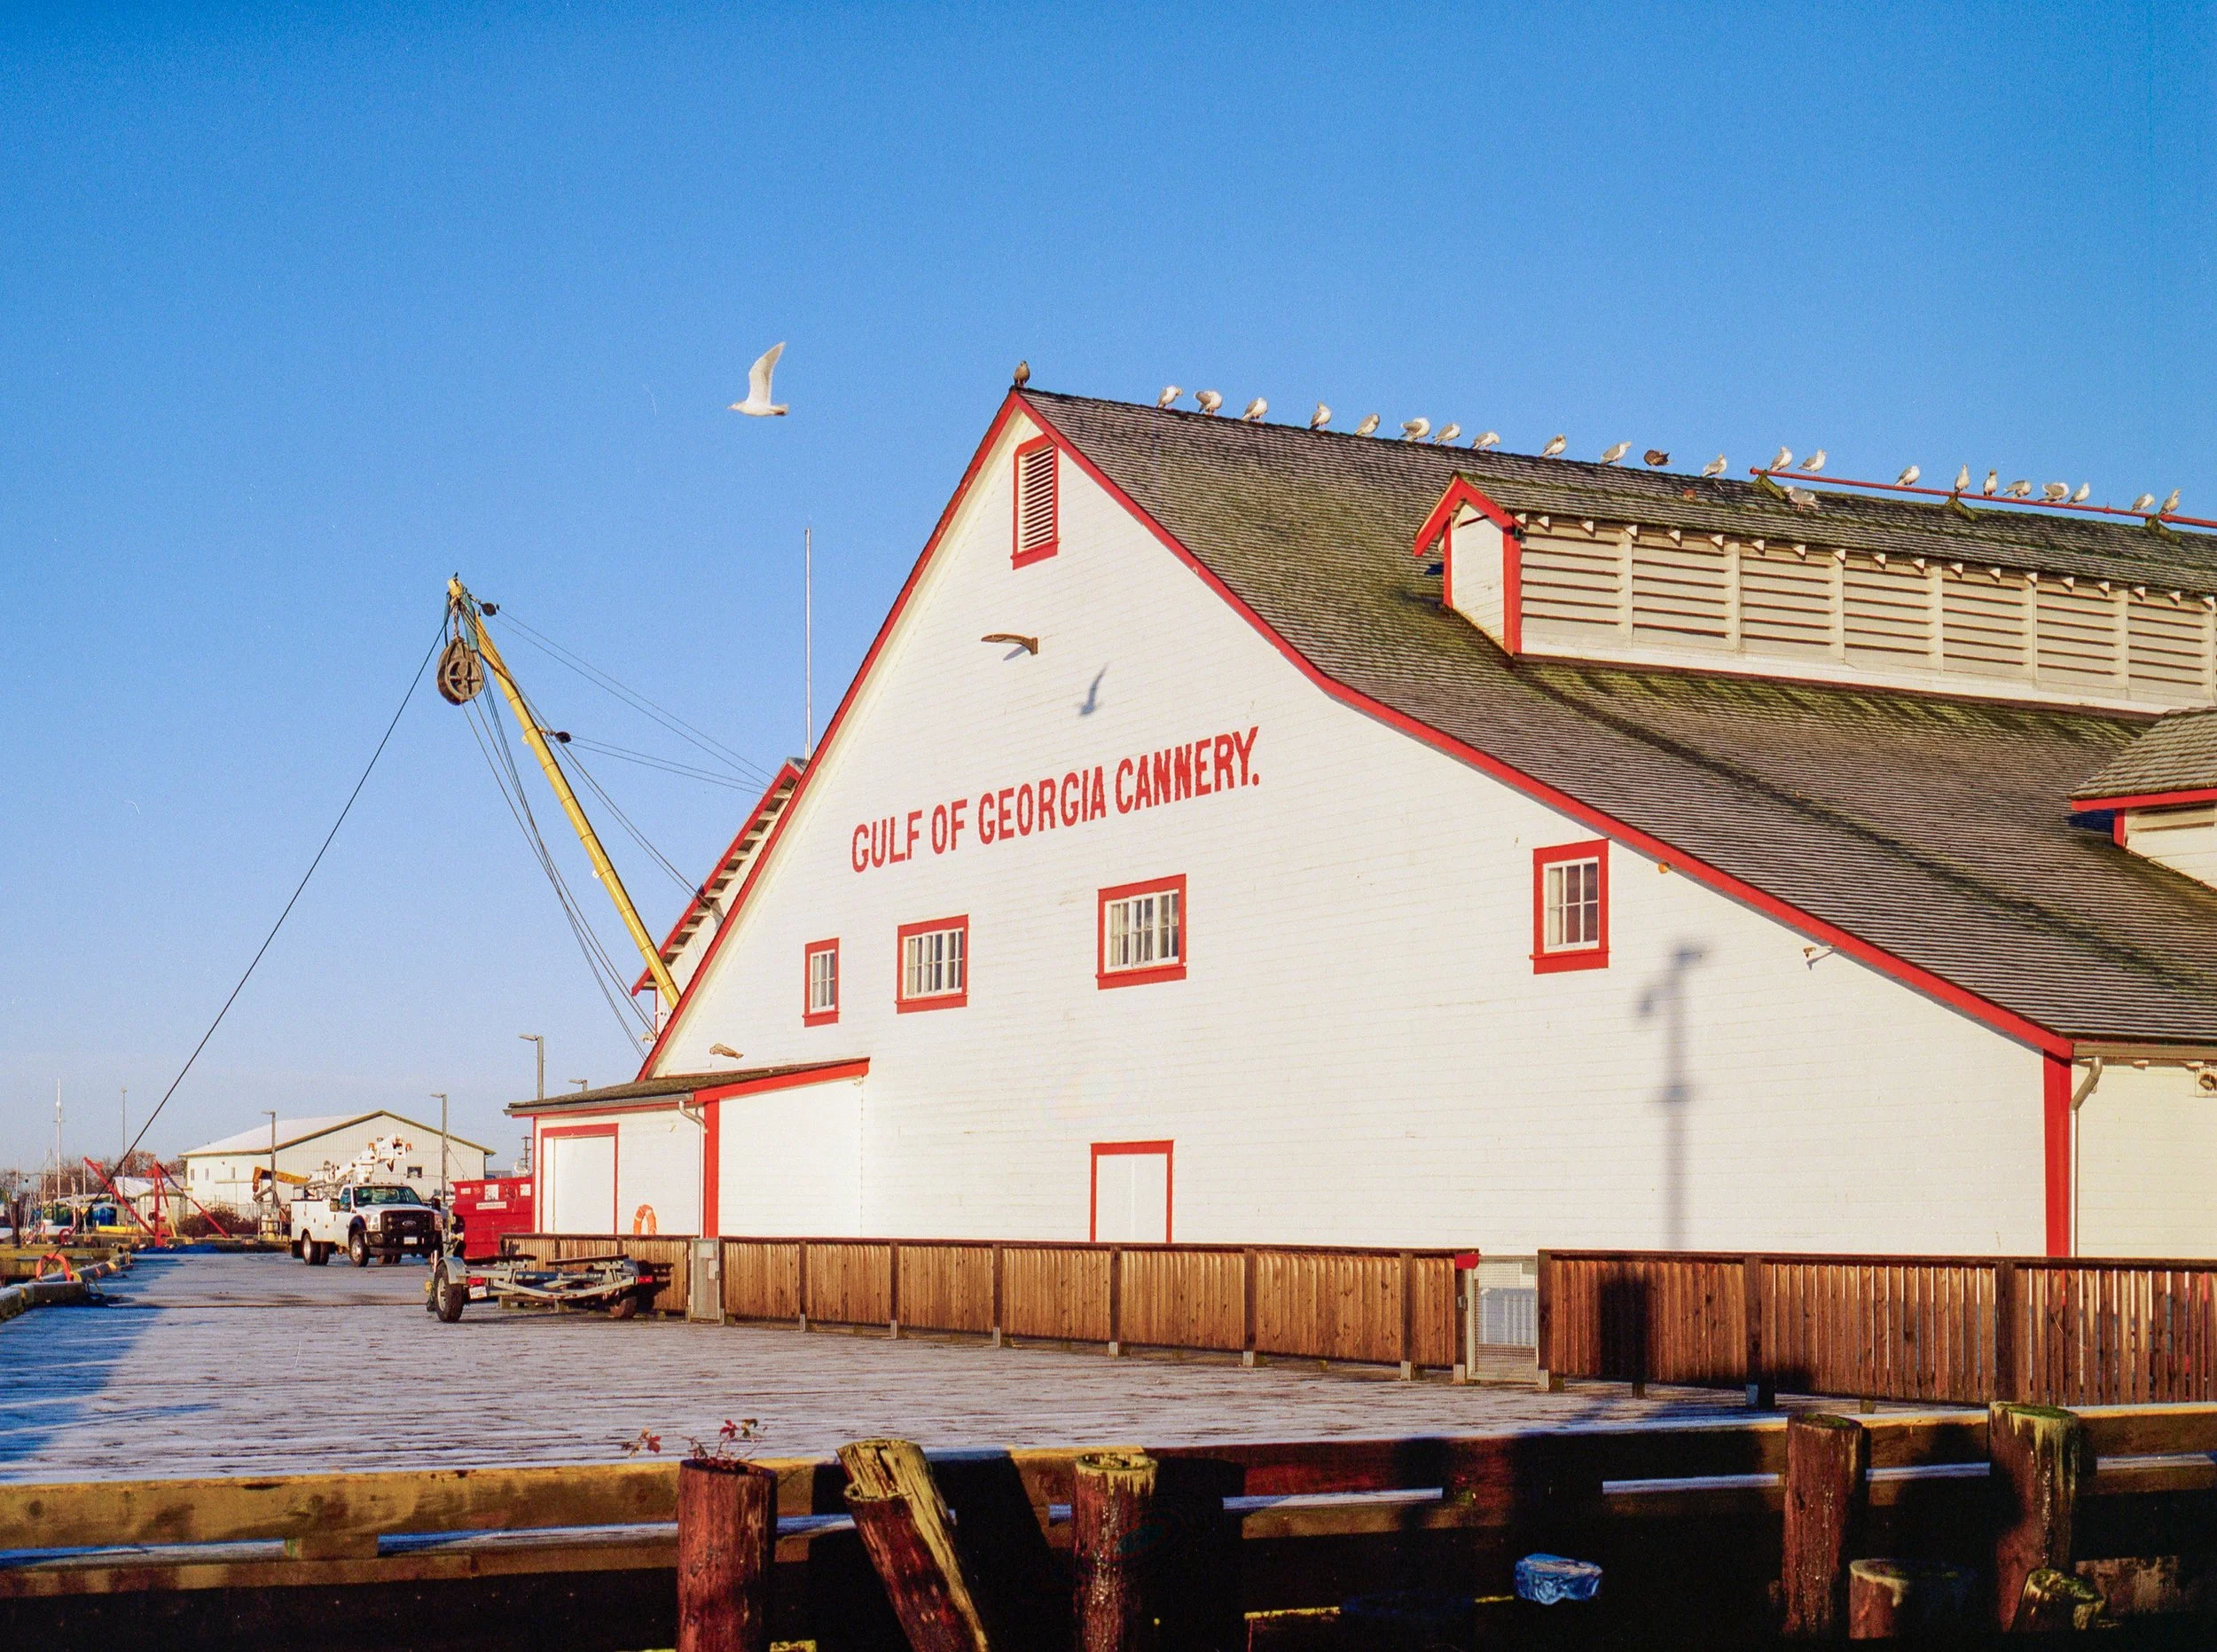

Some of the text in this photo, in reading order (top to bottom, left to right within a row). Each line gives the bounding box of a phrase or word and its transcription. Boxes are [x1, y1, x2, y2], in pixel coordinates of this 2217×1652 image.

[851, 726, 1260, 873] GULF OF GEORGIA CANNERY.
